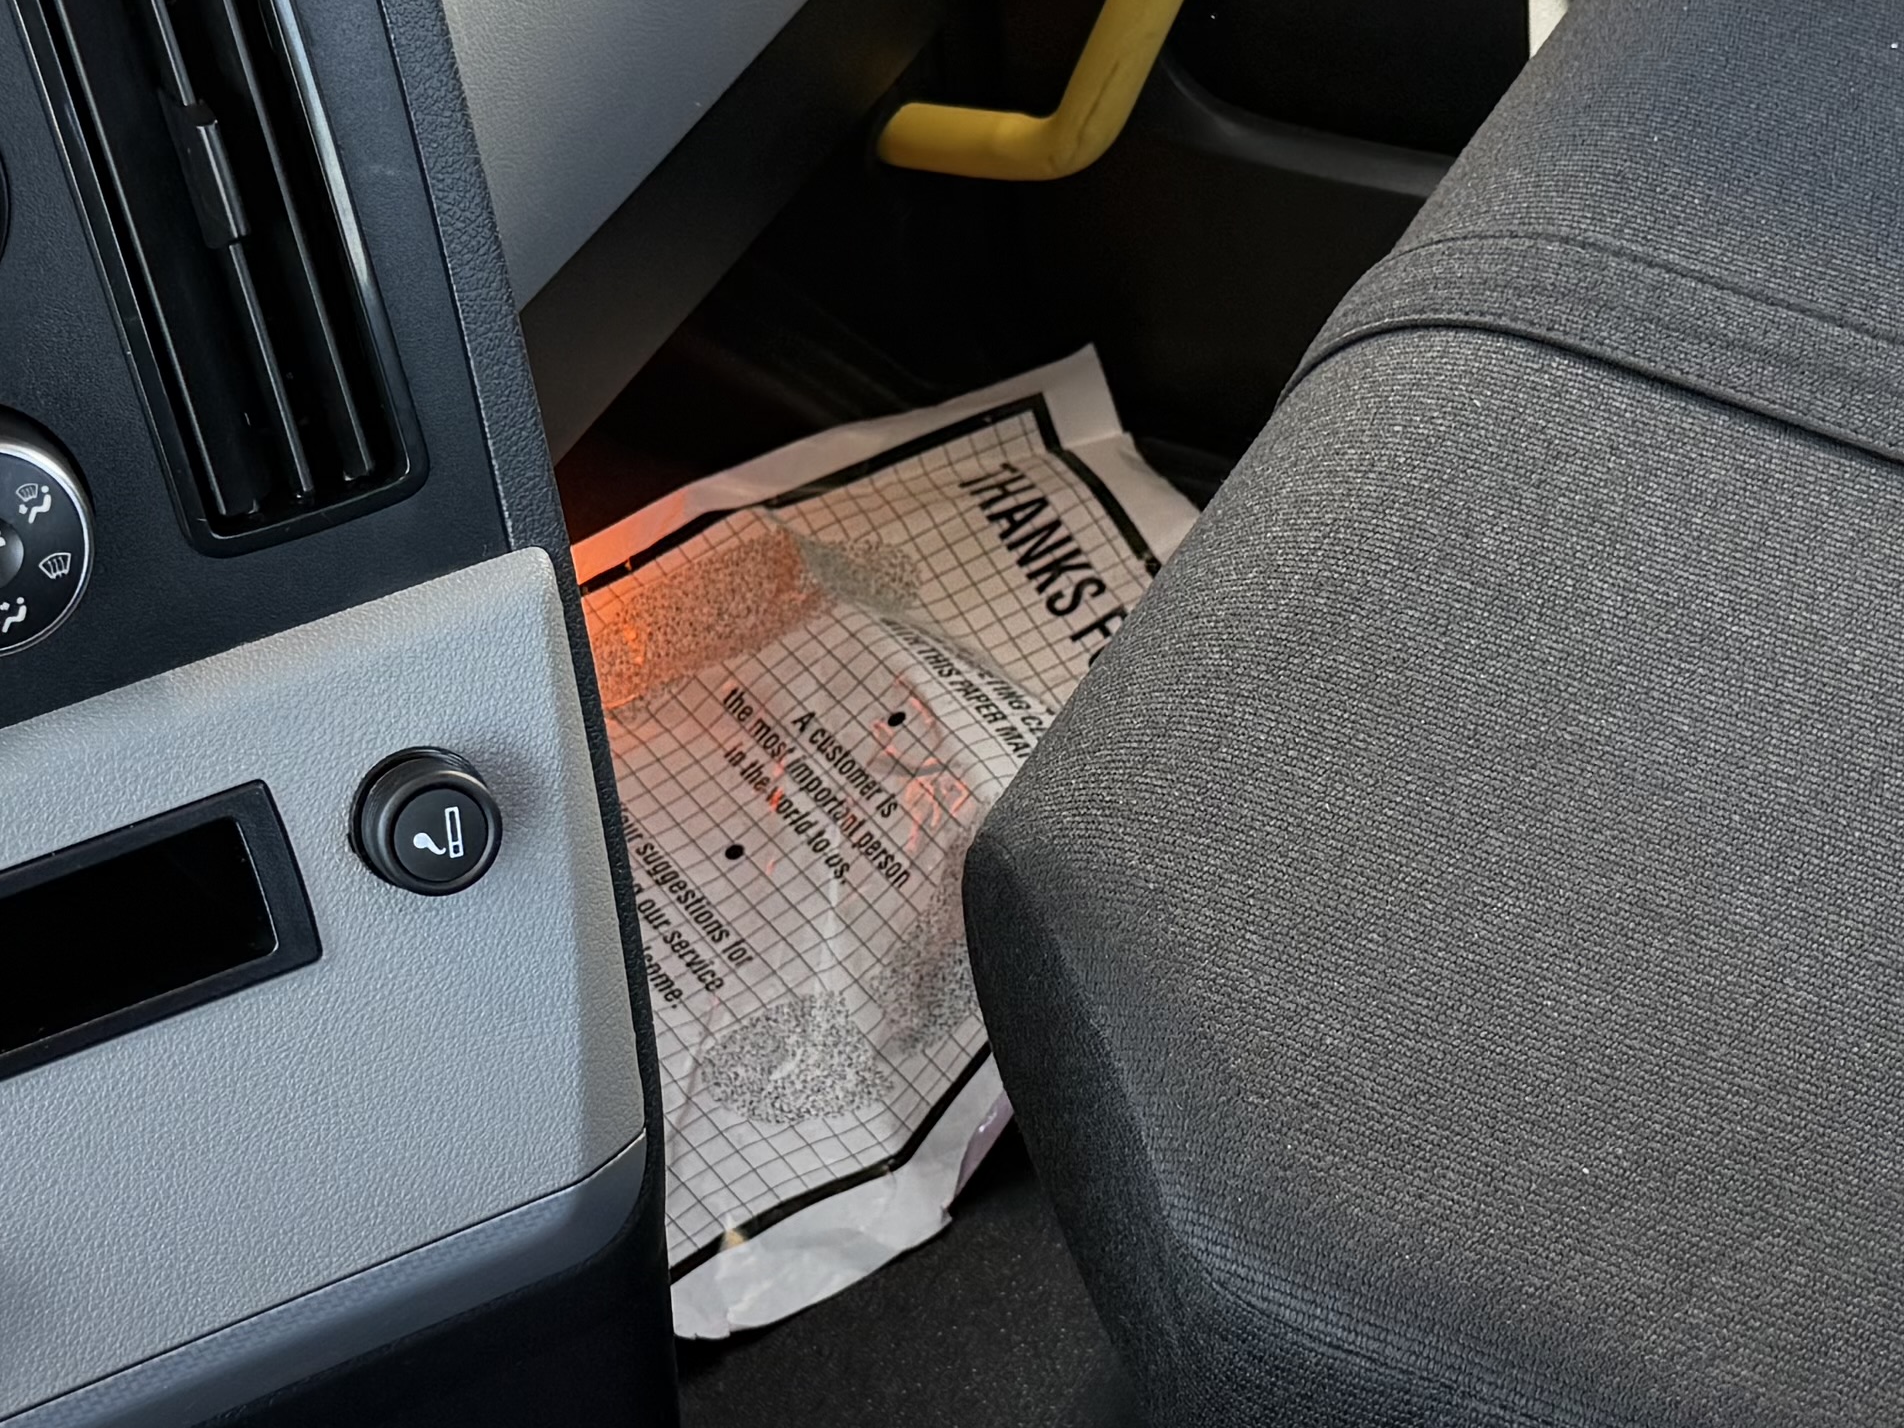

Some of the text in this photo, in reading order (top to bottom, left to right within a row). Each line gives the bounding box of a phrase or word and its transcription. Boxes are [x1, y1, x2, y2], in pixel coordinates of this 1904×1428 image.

[958, 462, 1106, 617] THANKS
[918, 644, 961, 679] THIS
[949, 673, 1004, 724] PAPER
[723, 688, 911, 888] the most important person
[724, 742, 746, 767] in
[741, 760, 771, 794] the
[766, 785, 820, 836] world
[807, 828, 831, 854] to
[792, 711, 898, 819] A customer is
[636, 841, 730, 944] suggestions
[722, 937, 754, 970] for
[637, 898, 725, 993] our service
